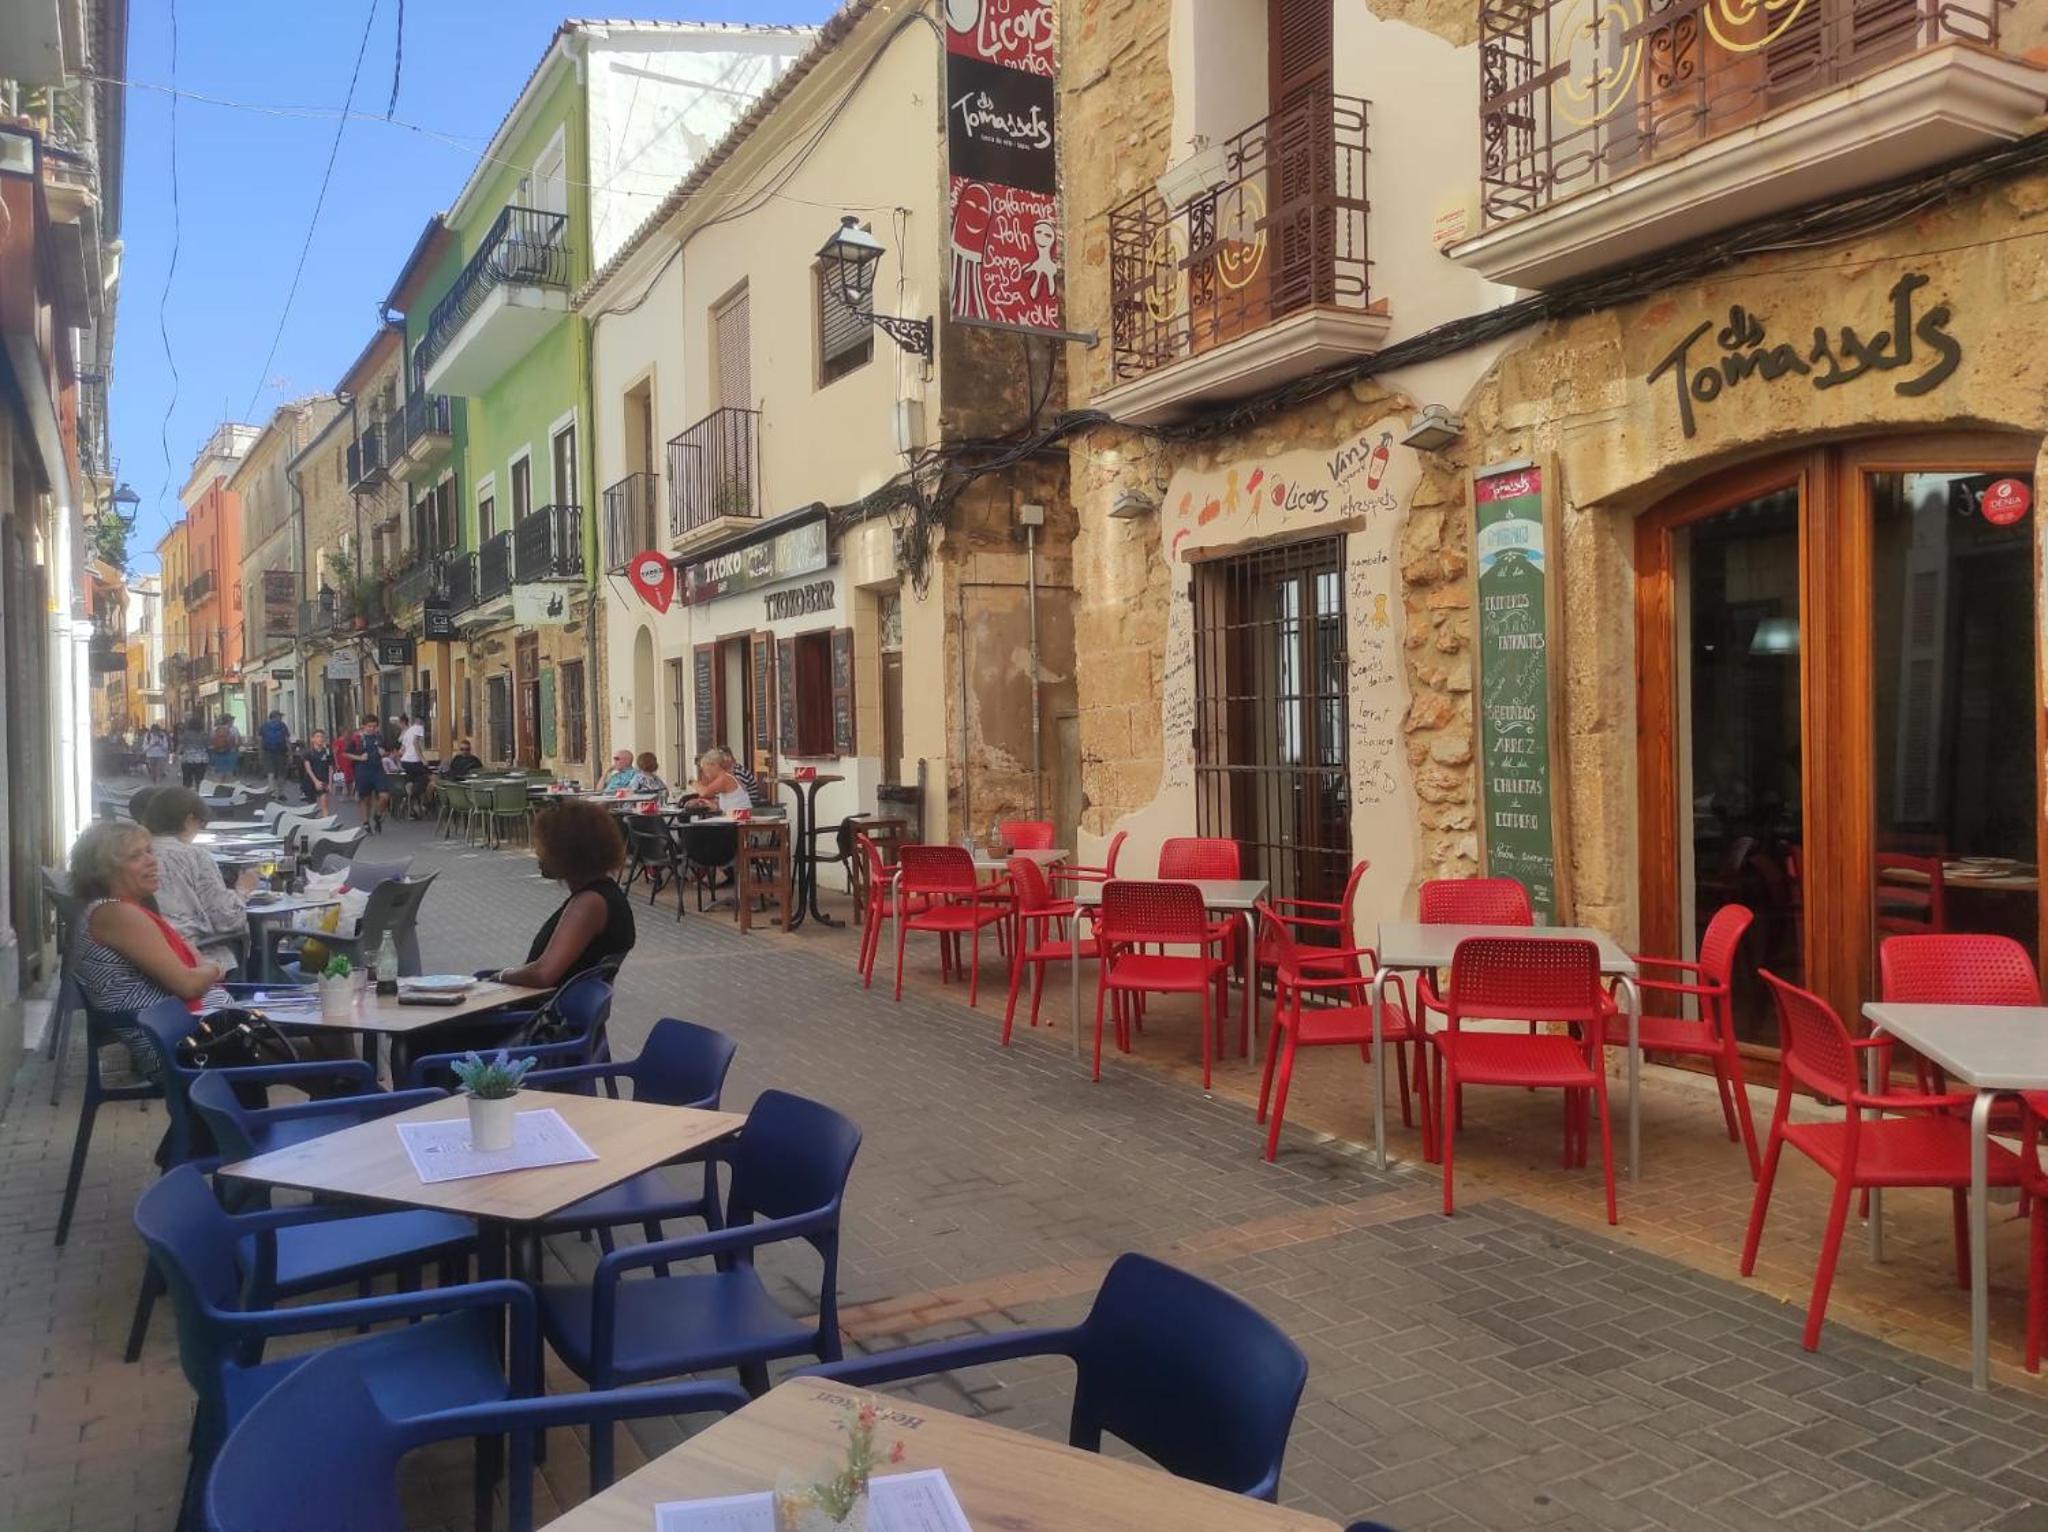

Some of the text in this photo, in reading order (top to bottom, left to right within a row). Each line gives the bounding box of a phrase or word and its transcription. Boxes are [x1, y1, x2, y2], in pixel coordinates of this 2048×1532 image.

[1646, 272, 1962, 439] Tomassets
[1327, 437, 1370, 481] Vins
[1285, 480, 1329, 512] Licors
[704, 551, 741, 583] TXOKO
[1493, 737, 1535, 754] ARROZ
[1493, 777, 1542, 793] CHULETAS
[1495, 812, 1538, 829] CORDERO
